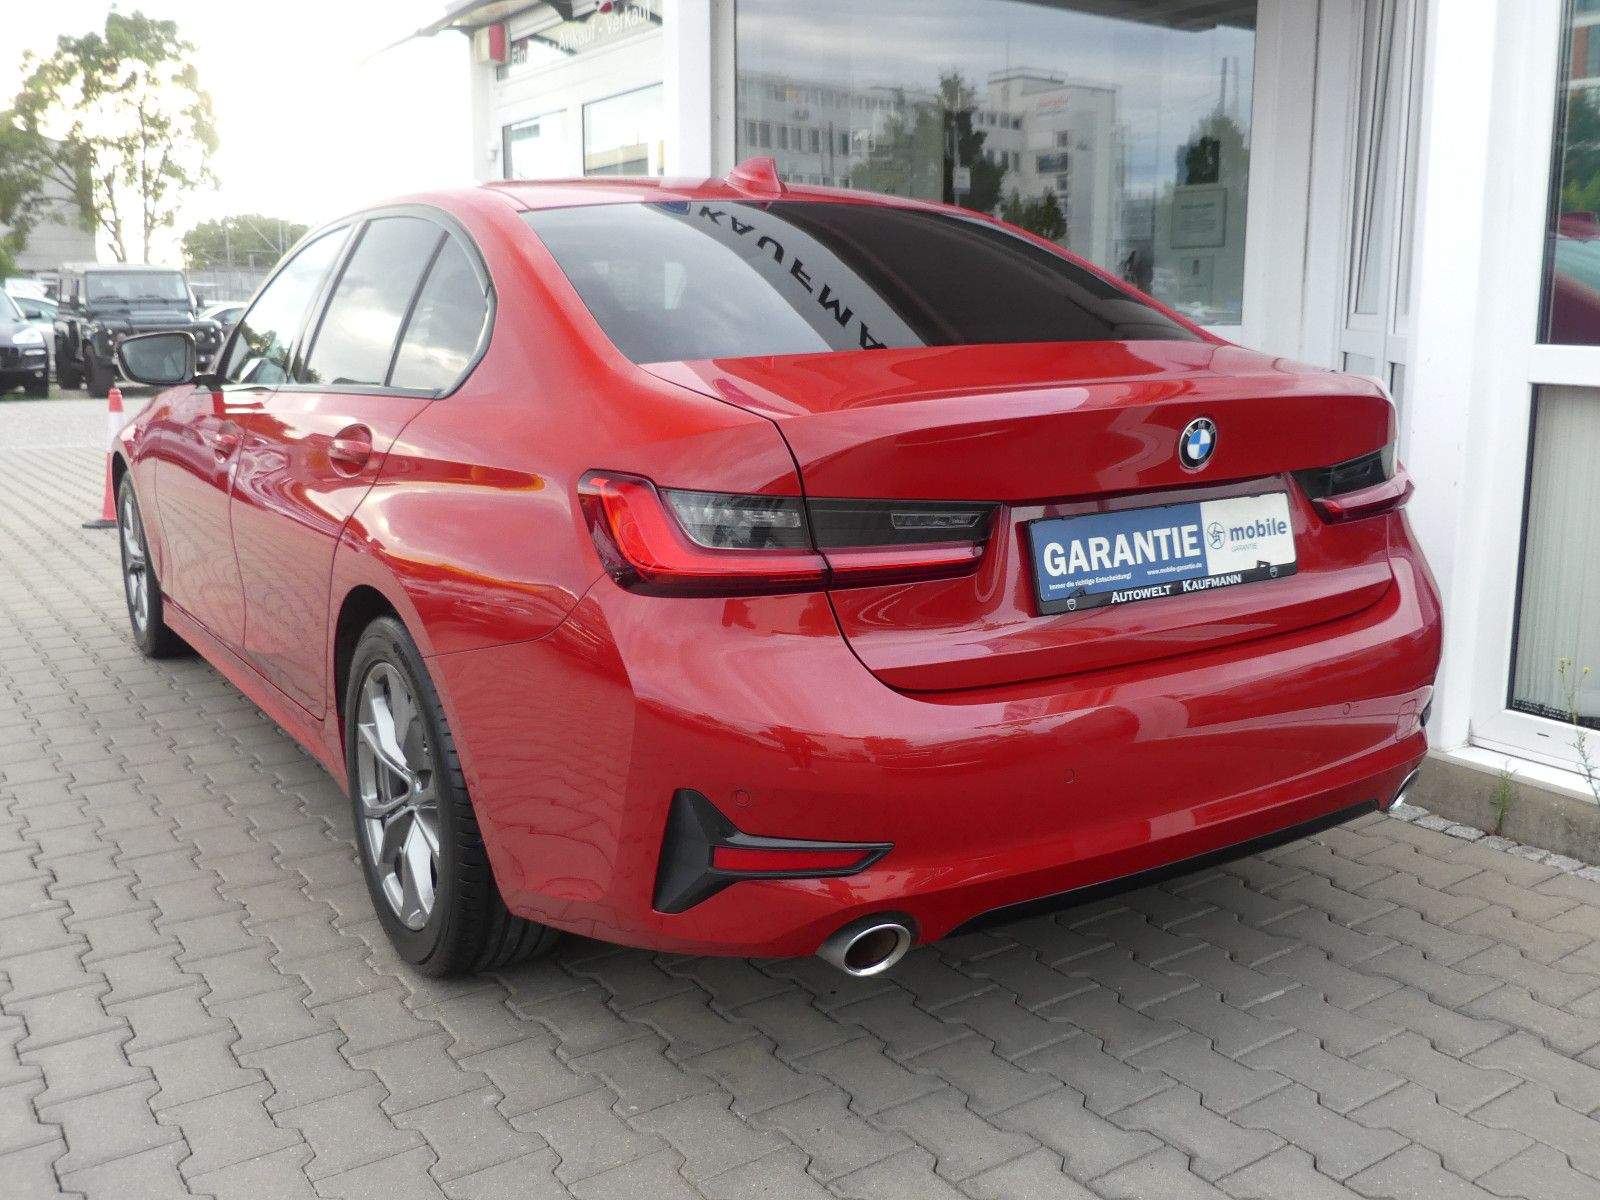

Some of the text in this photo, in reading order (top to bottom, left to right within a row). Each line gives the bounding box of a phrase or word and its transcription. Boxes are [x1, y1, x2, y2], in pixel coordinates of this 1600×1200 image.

[1230, 518, 1287, 541] mobile
[1044, 524, 1200, 577] GARANTIE
[1111, 573, 1242, 604] AUTOWELT KAUFMANN
